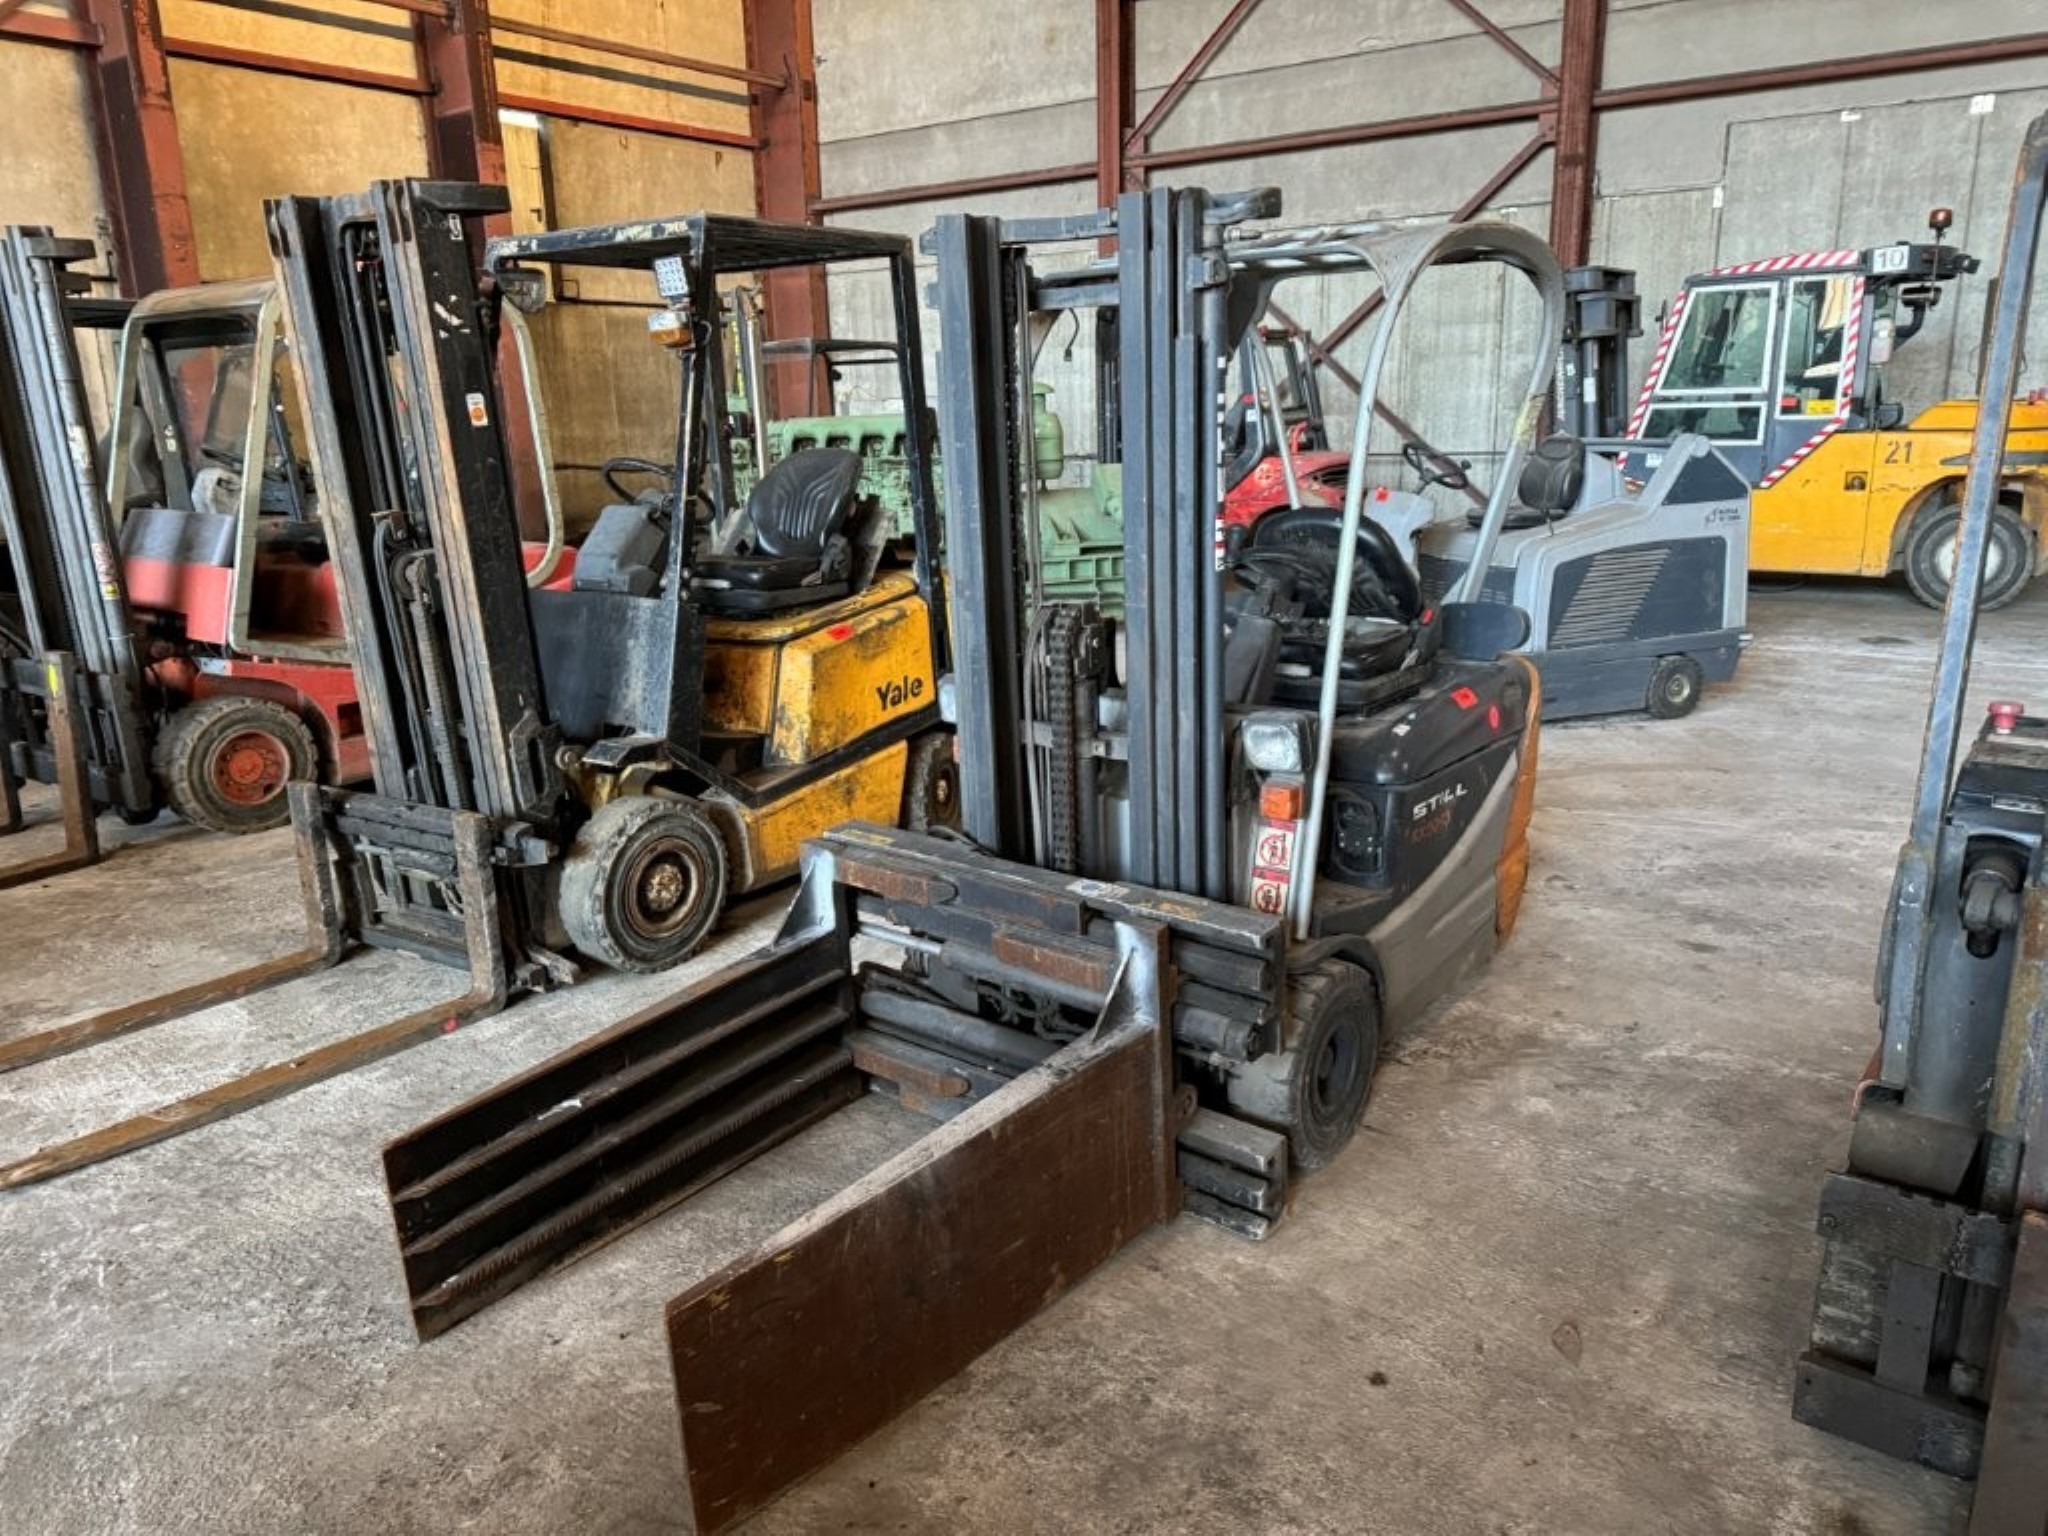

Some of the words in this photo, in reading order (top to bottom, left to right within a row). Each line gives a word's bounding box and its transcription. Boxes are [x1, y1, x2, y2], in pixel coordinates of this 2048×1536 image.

[1878, 250, 1905, 269] 10
[1885, 440, 1912, 464] 21
[876, 674, 924, 711] Yale
[1412, 783, 1469, 820] STILL
